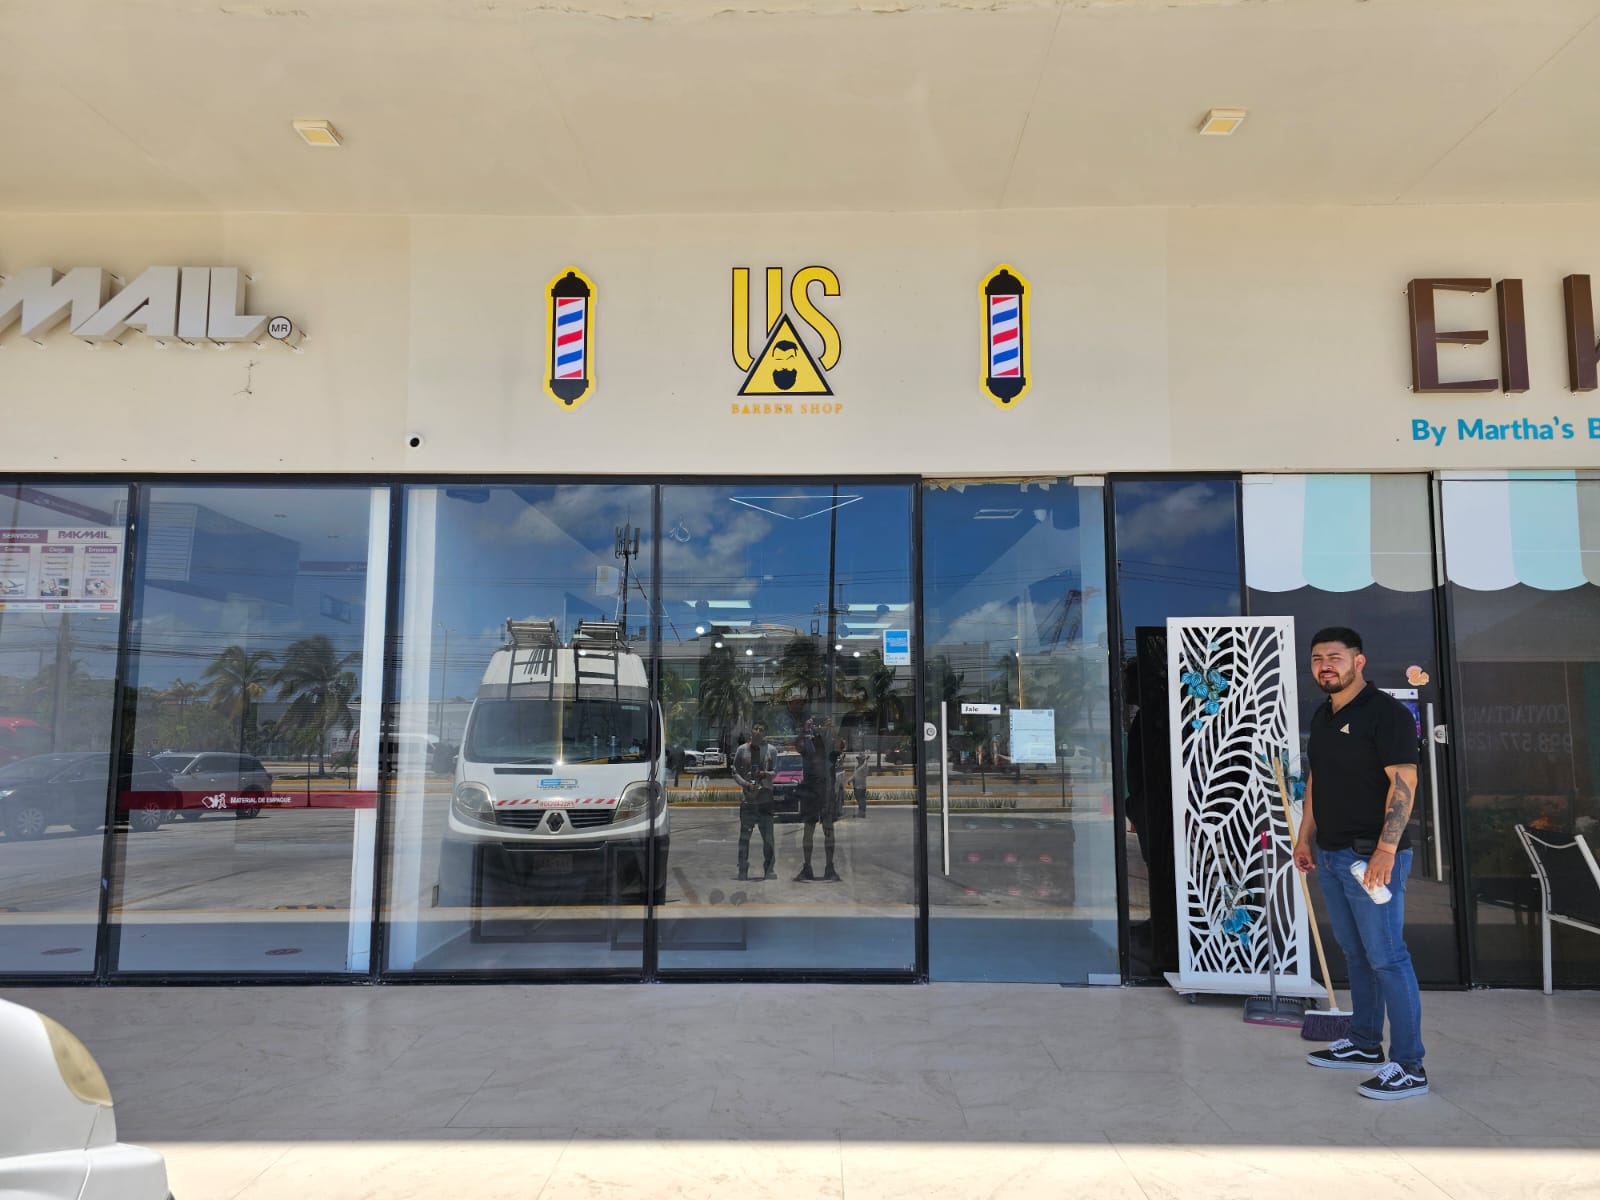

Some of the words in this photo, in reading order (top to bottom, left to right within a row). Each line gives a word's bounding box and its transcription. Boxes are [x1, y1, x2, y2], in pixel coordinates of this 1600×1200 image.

[731, 265, 842, 372] US
[731, 403, 793, 414] BARBER
[800, 403, 843, 414] SHOP
[1411, 419, 1446, 446] By
[1457, 416, 1574, 440] Martha's
[58, 531, 110, 539] PAKMAIL
